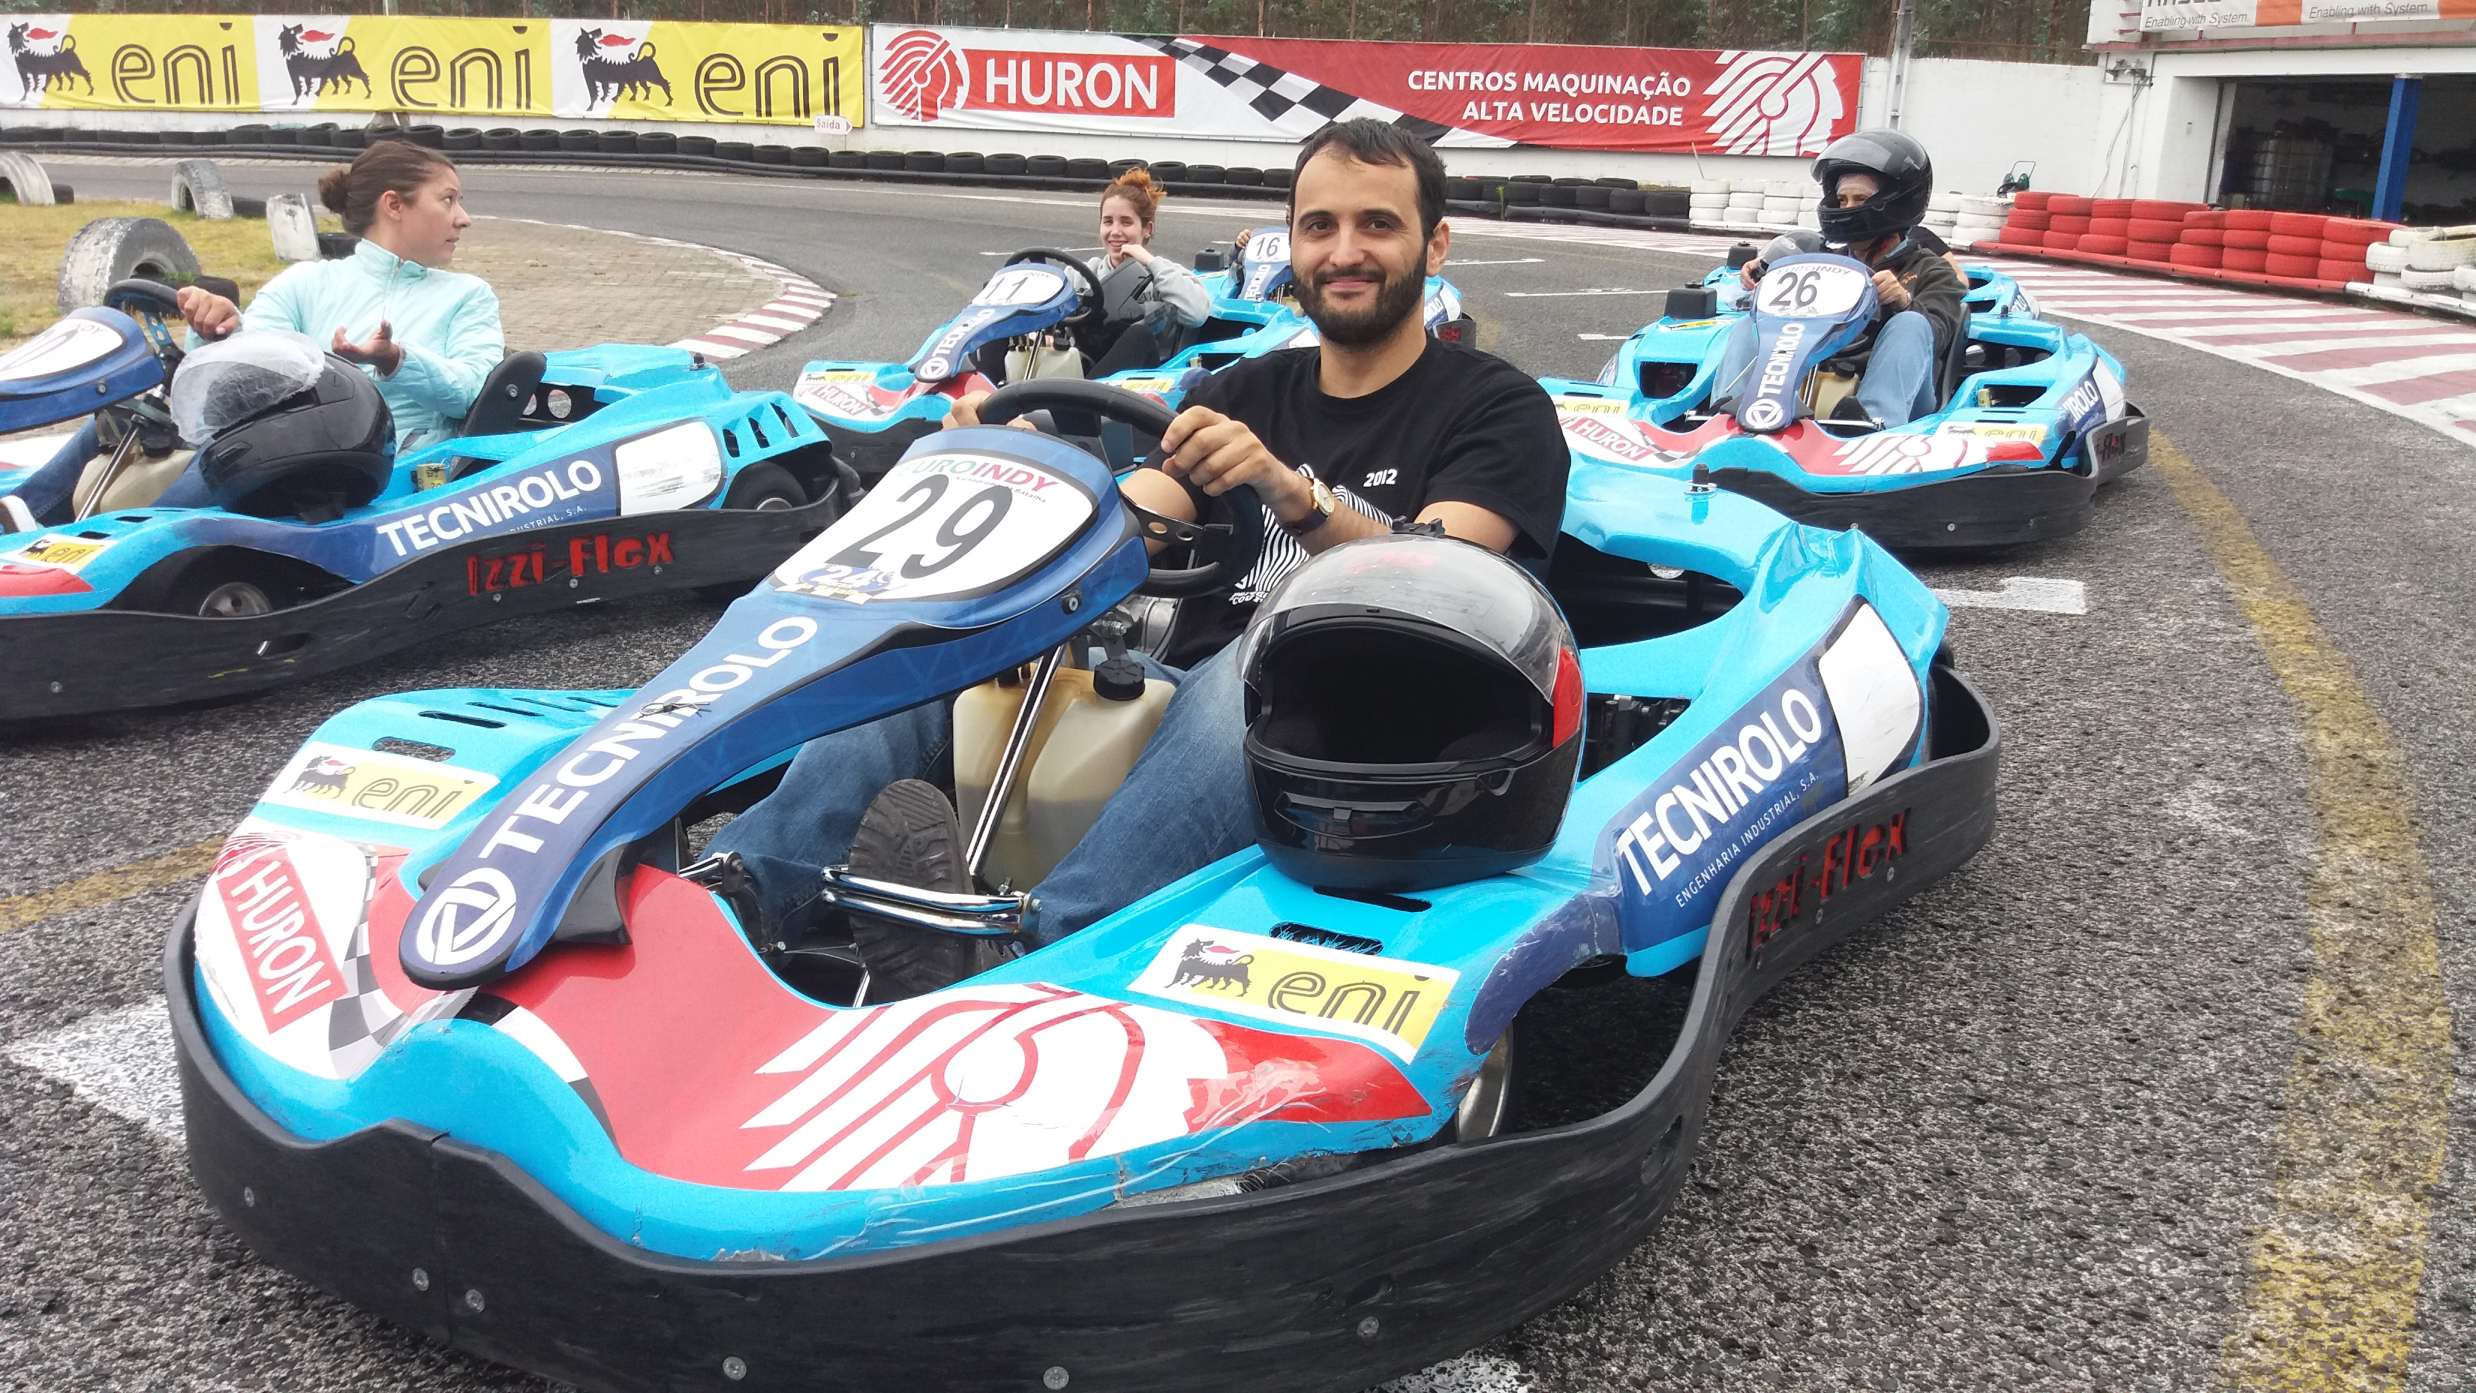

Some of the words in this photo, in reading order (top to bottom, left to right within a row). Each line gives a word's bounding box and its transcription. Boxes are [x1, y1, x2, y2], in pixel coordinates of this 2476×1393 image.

[2145, 16, 2186, 28] Enabling
[2309, 6, 2354, 18] Enabling
[2357, 6, 2381, 15] with
[112, 22, 240, 105] eni
[392, 25, 531, 109] eni
[695, 32, 841, 118] eni
[986, 58, 1158, 110] HURON
[1407, 71, 1517, 92] CENTROS
[1523, 72, 1691, 100] MAQUINAÇÃO
[1462, 101, 1524, 121] ALTA
[1530, 103, 1684, 126] VELOCIDADE
[1256, 237, 1280, 257] 16
[1769, 271, 1821, 309] 26
[1575, 420, 1646, 459] HURON
[1363, 469, 1398, 488] 2012
[376, 460, 603, 557] TECNIROLO
[825, 472, 1014, 581] 29
[480, 617, 818, 860] TECNIROLO
[353, 774, 475, 820] eni
[1617, 688, 1823, 896] TECNIROLO
[1675, 842, 1741, 908] ENGENHARIA
[232, 860, 332, 1016] HURON
[1268, 971, 1430, 1035] eni
